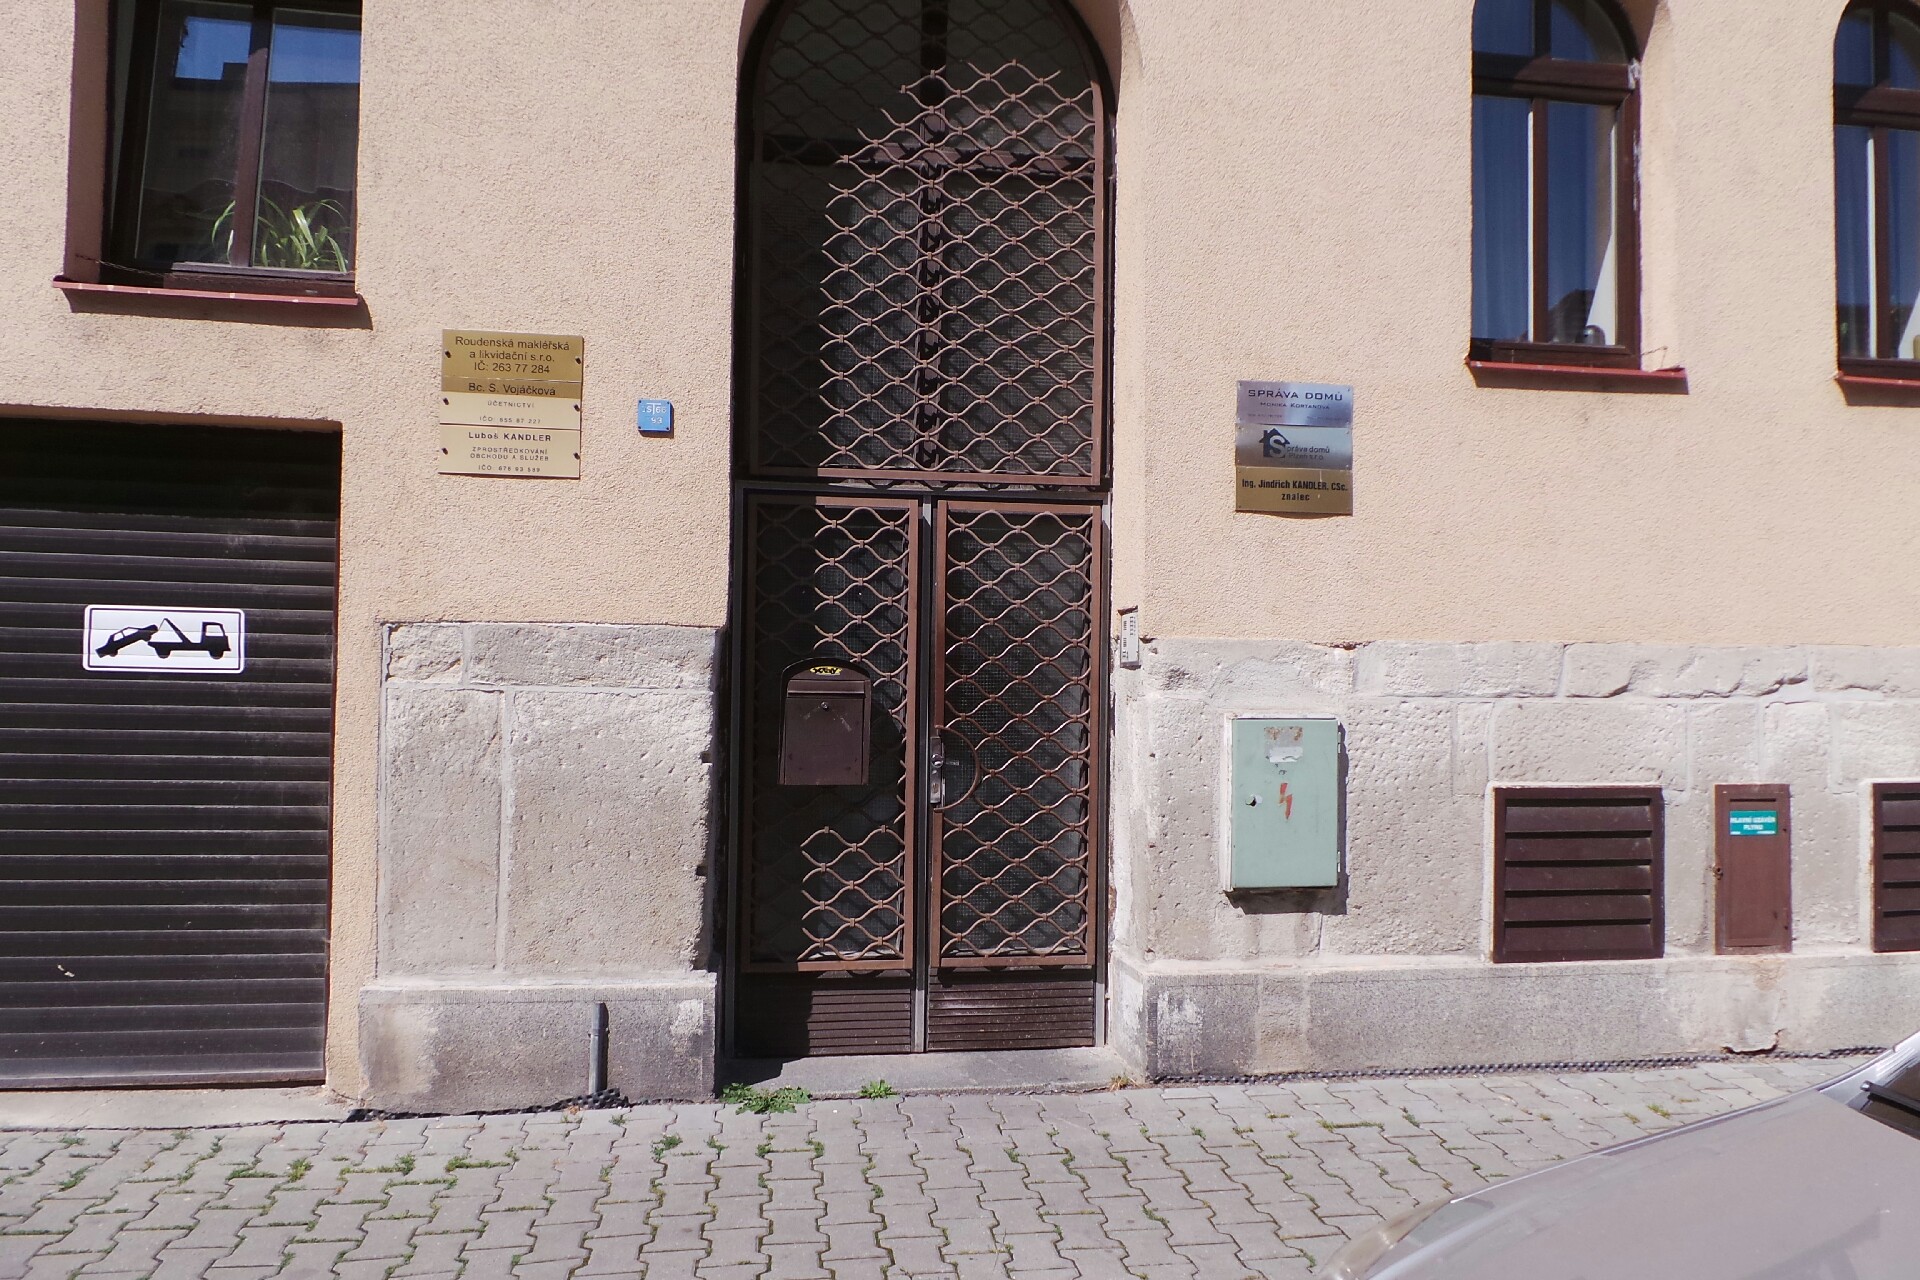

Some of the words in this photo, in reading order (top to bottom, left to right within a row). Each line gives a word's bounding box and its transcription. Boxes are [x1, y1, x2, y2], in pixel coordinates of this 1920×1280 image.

[455, 336, 514, 348] Roudenská
[517, 339, 570, 351] makléřská
[469, 351, 476, 359] a
[479, 350, 528, 361] likvidační
[530, 354, 555, 362] s.r.o.
[474, 361, 489, 371] IČ:
[492, 363, 512, 372] 263
[515, 364, 528, 373] 77
[531, 365, 551, 374] 284
[468, 382, 485, 392] Bc.
[503, 384, 556, 396] Vojáčková
[1248, 388, 1299, 399] SPRÁVA
[1305, 392, 1343, 401] DOMŮ
[468, 432, 499, 440] Luboš
[503, 432, 551, 442] KANDLER
[1242, 479, 1256, 488] Ing.
[1258, 480, 1291, 489] Jindřich
[1281, 493, 1310, 501] znalec
